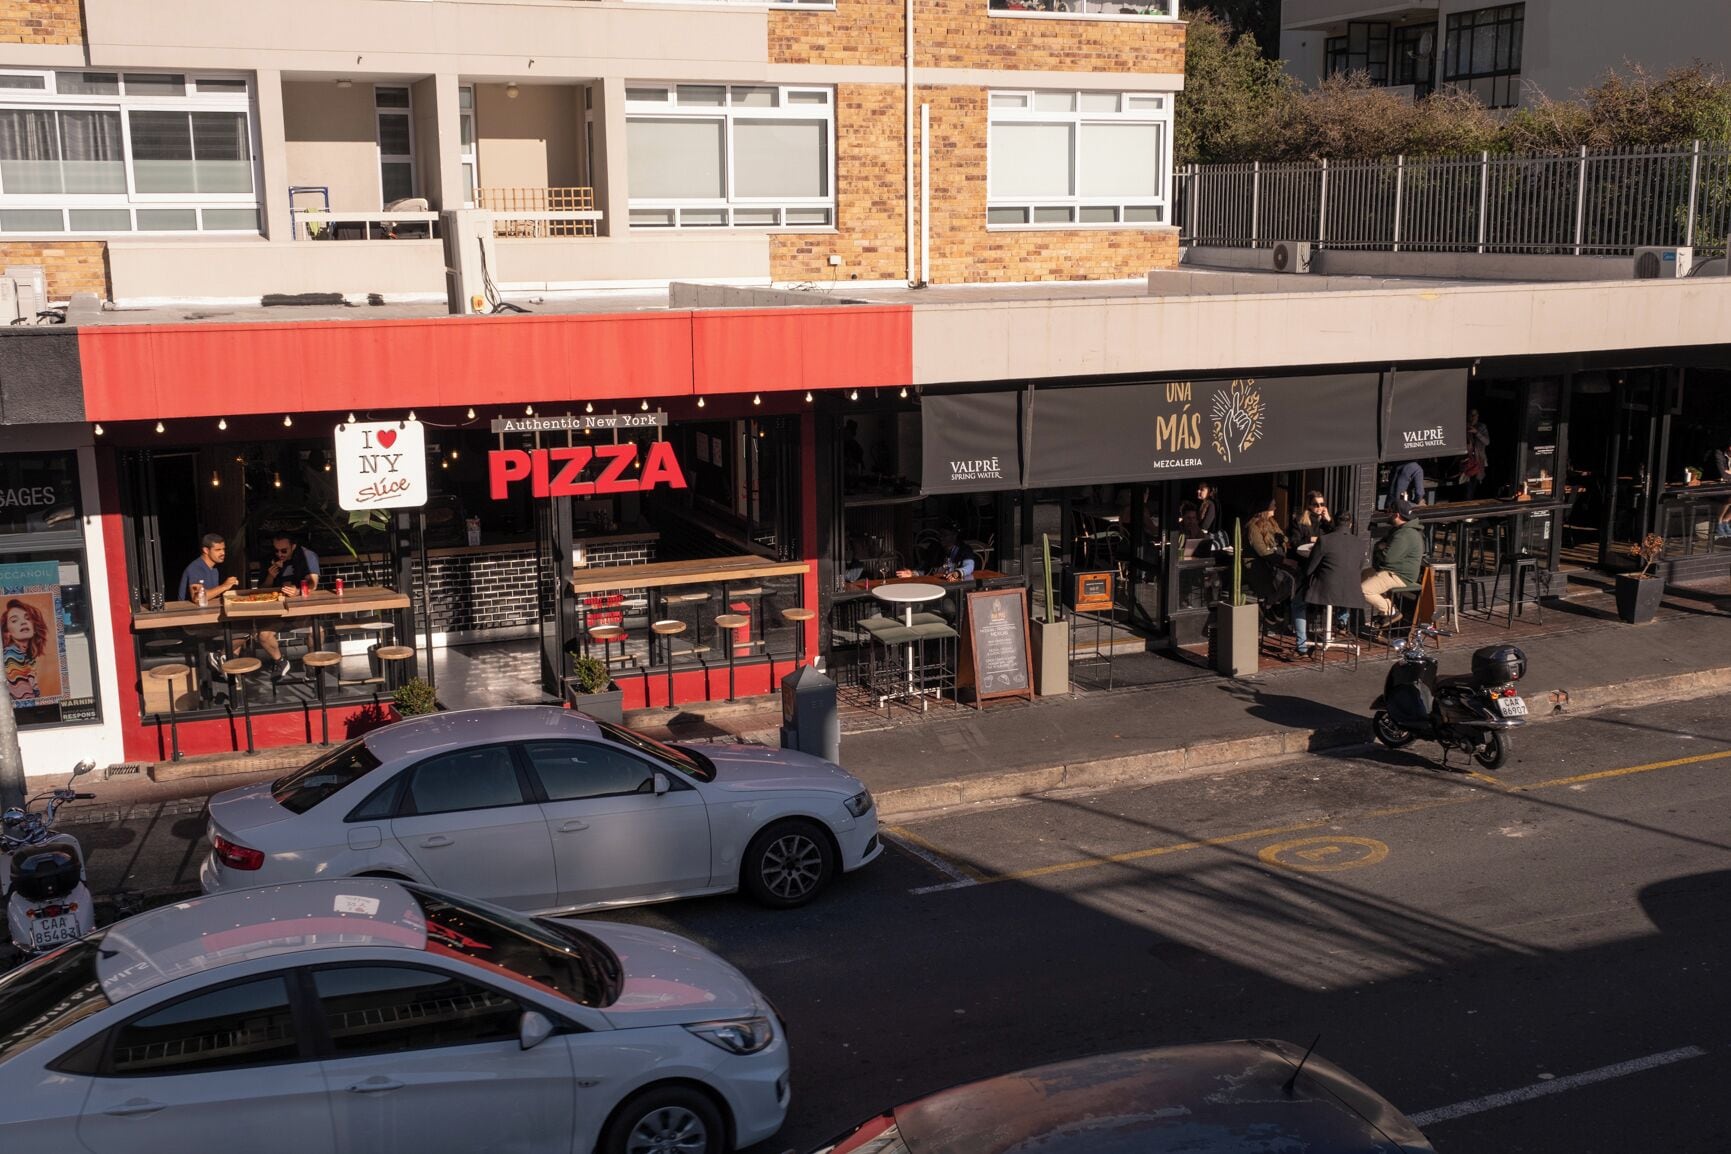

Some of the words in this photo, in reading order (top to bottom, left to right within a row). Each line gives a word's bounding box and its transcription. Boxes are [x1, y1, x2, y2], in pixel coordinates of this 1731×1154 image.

[1166, 382, 1192, 403] UNA
[504, 418, 580, 431] Authentic
[586, 416, 616, 428] New
[622, 415, 657, 426] York
[1156, 403, 1201, 452] MÁS
[362, 430, 373, 449] I
[1404, 441, 1425, 449] SPRING
[1424, 439, 1447, 447] WATER
[358, 453, 404, 474] NY
[488, 441, 688, 500] PIZZA
[1153, 458, 1203, 469] MEZCALERIA
[951, 472, 976, 480] SPRING
[977, 471, 1003, 479] WATER
[41, 917, 67, 930] CAA
